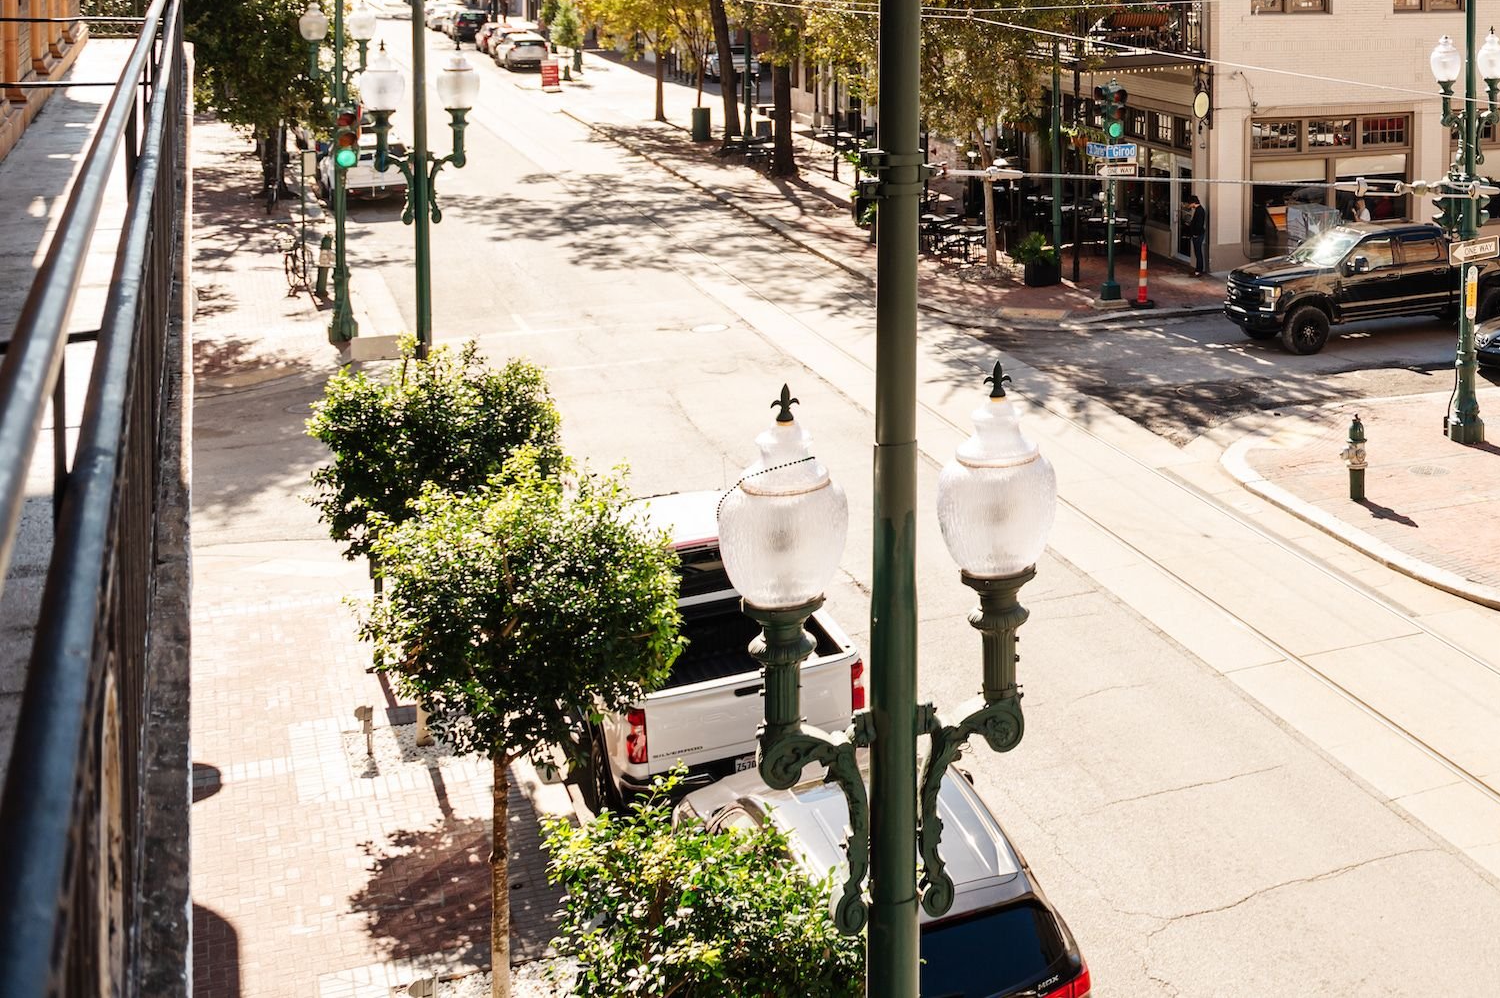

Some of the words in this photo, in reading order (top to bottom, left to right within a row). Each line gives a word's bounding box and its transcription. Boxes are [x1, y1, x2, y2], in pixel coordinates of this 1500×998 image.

[1112, 145, 1135, 157] Girod
[1464, 247, 1477, 256] ONE
[1479, 243, 1494, 253] WAY
[736, 760, 757, 772] Z570
[1037, 974, 1060, 991] MDX
